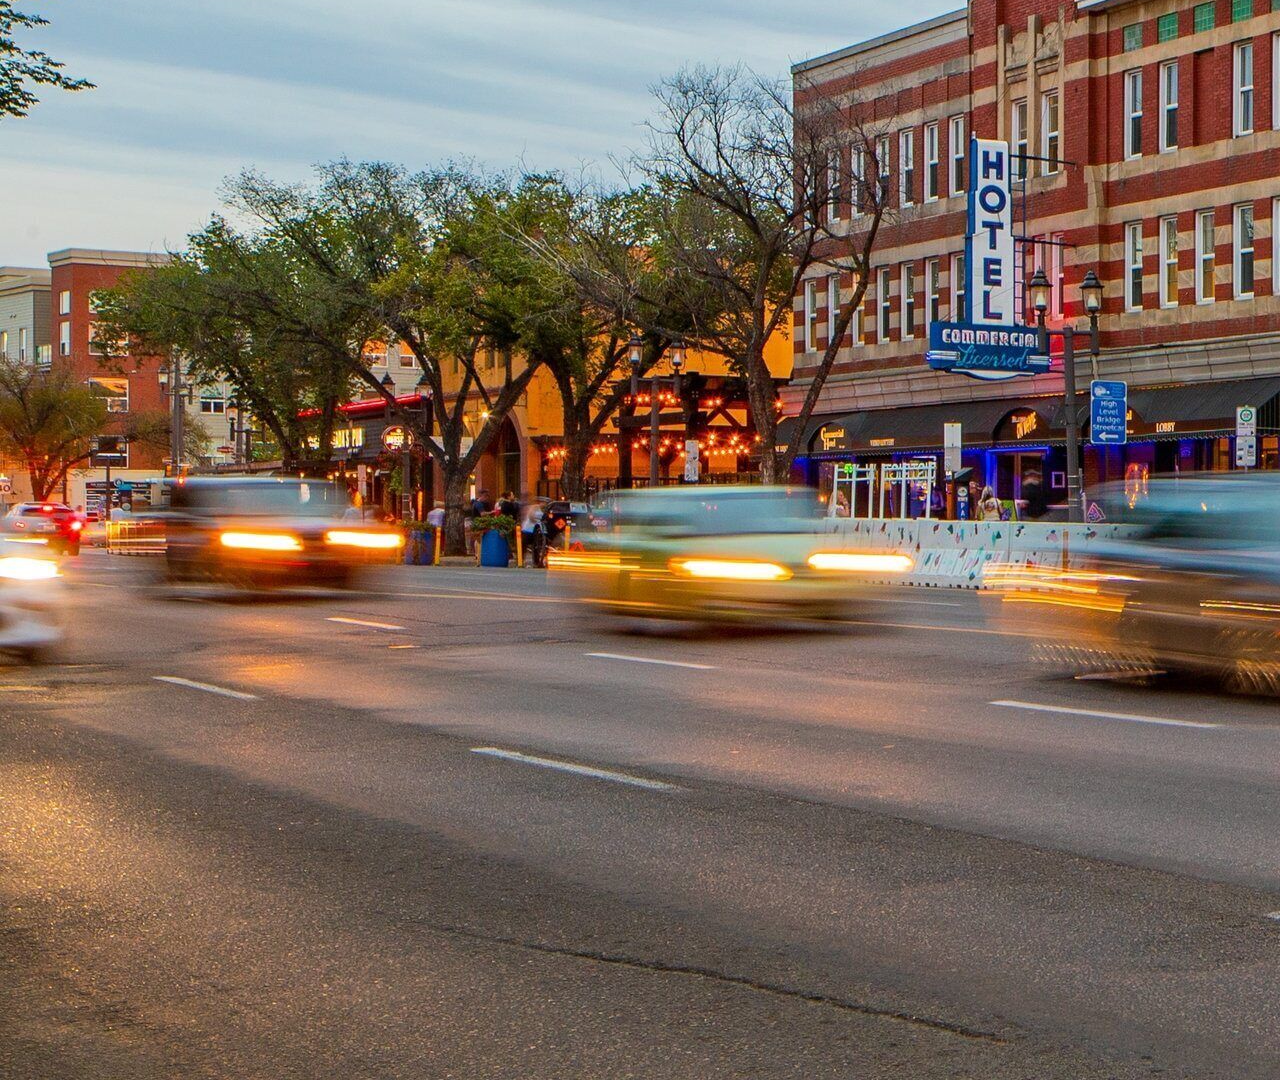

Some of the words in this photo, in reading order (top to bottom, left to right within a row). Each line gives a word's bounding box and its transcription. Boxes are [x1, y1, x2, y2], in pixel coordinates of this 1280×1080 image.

[979, 151, 1007, 320] HOTEL
[955, 344, 1029, 369] Licensed
[1101, 400, 1118, 409] High
[1099, 408, 1119, 416] Level
[1096, 416, 1121, 425] Bridge
[1155, 421, 1176, 433] LOBBY
